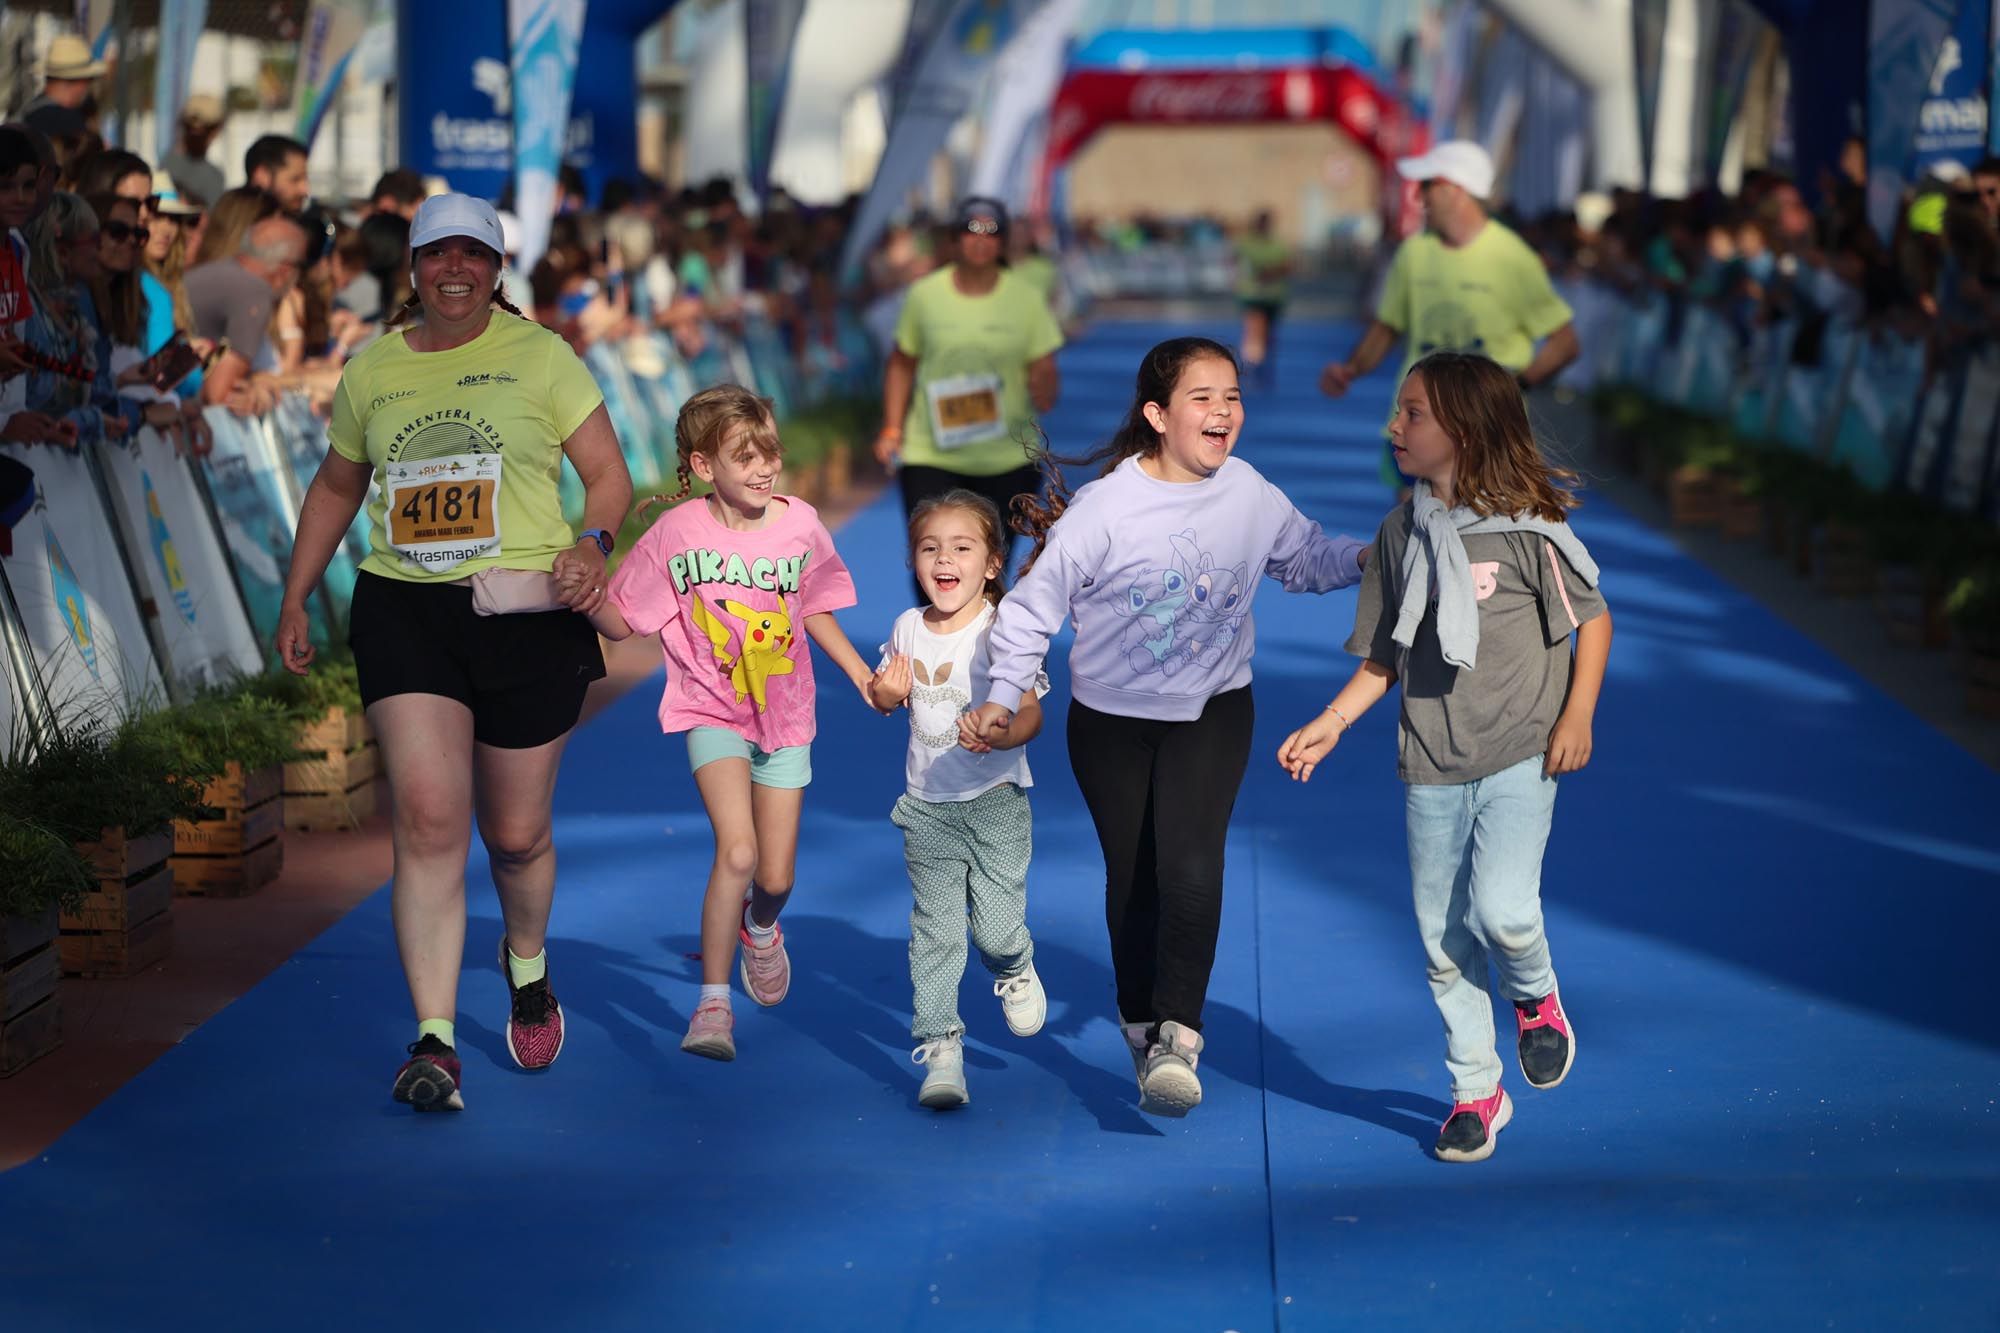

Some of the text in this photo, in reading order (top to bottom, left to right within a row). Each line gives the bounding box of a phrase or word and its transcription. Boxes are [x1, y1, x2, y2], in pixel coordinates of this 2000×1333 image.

[387, 409, 504, 462] FORMENTERA 2024
[402, 485, 481, 524] 4181
